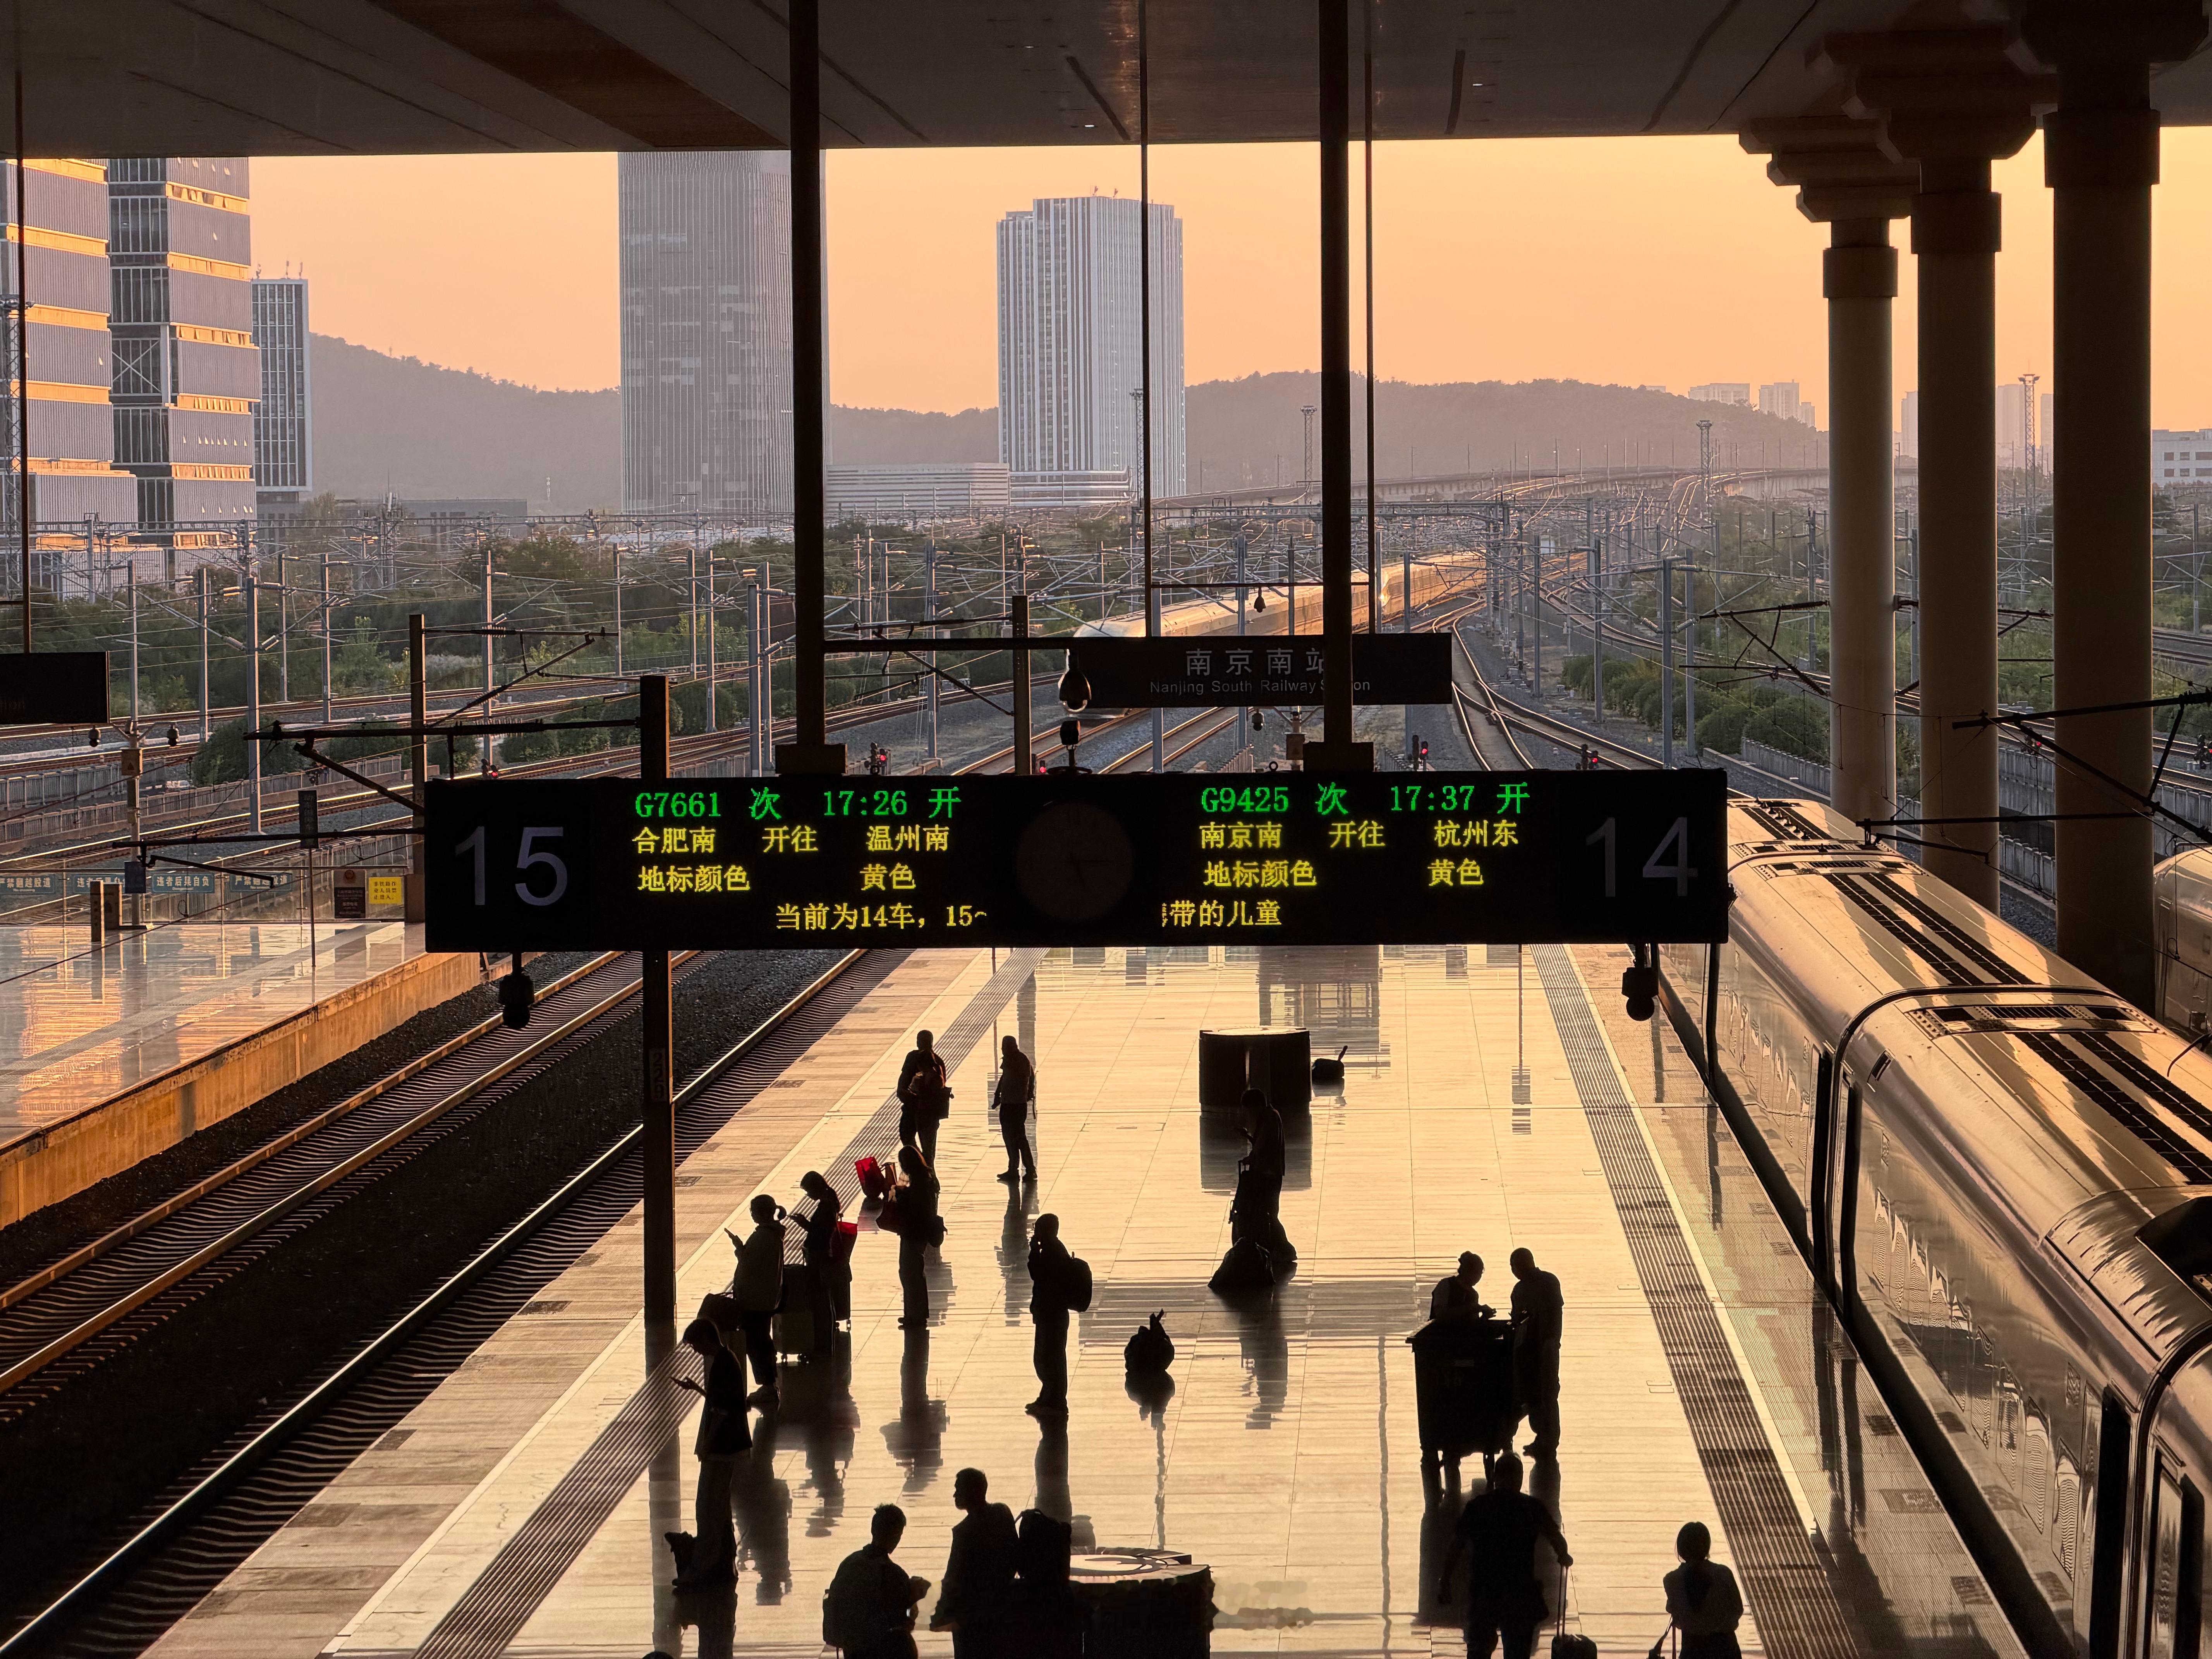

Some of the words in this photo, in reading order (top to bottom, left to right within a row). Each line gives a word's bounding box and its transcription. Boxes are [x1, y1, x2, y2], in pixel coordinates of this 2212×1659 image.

[1186, 648, 1323, 676] 南京南站
[1151, 681, 1204, 696] Nanjing
[1212, 680, 1252, 693] South
[1261, 680, 1316, 694] Railway
[635, 792, 721, 817] G7661
[749, 787, 781, 820] 次
[824, 790, 907, 816] 17:26
[928, 787, 961, 818] 开
[1201, 787, 1288, 812] G9425
[1315, 782, 1348, 815] 次
[1391, 786, 1474, 811] 17:37
[1497, 782, 1530, 814] 开
[632, 826, 716, 854] 合肥南
[762, 825, 818, 853] 开往
[866, 824, 950, 852] 温州南
[1199, 821, 1283, 849] 南京南
[1329, 820, 1386, 848] 开往
[1434, 819, 1518, 847] 杭州东
[455, 826, 567, 906] 15
[1585, 816, 1698, 897] 14
[157, 876, 209, 886] 违者后果自负
[637, 865, 750, 892] 地标颜色
[859, 863, 916, 891] 黄色
[1203, 860, 1317, 888] 地标颜色
[1427, 859, 1484, 886] 黄色
[1162, 899, 1282, 927] 带的儿童
